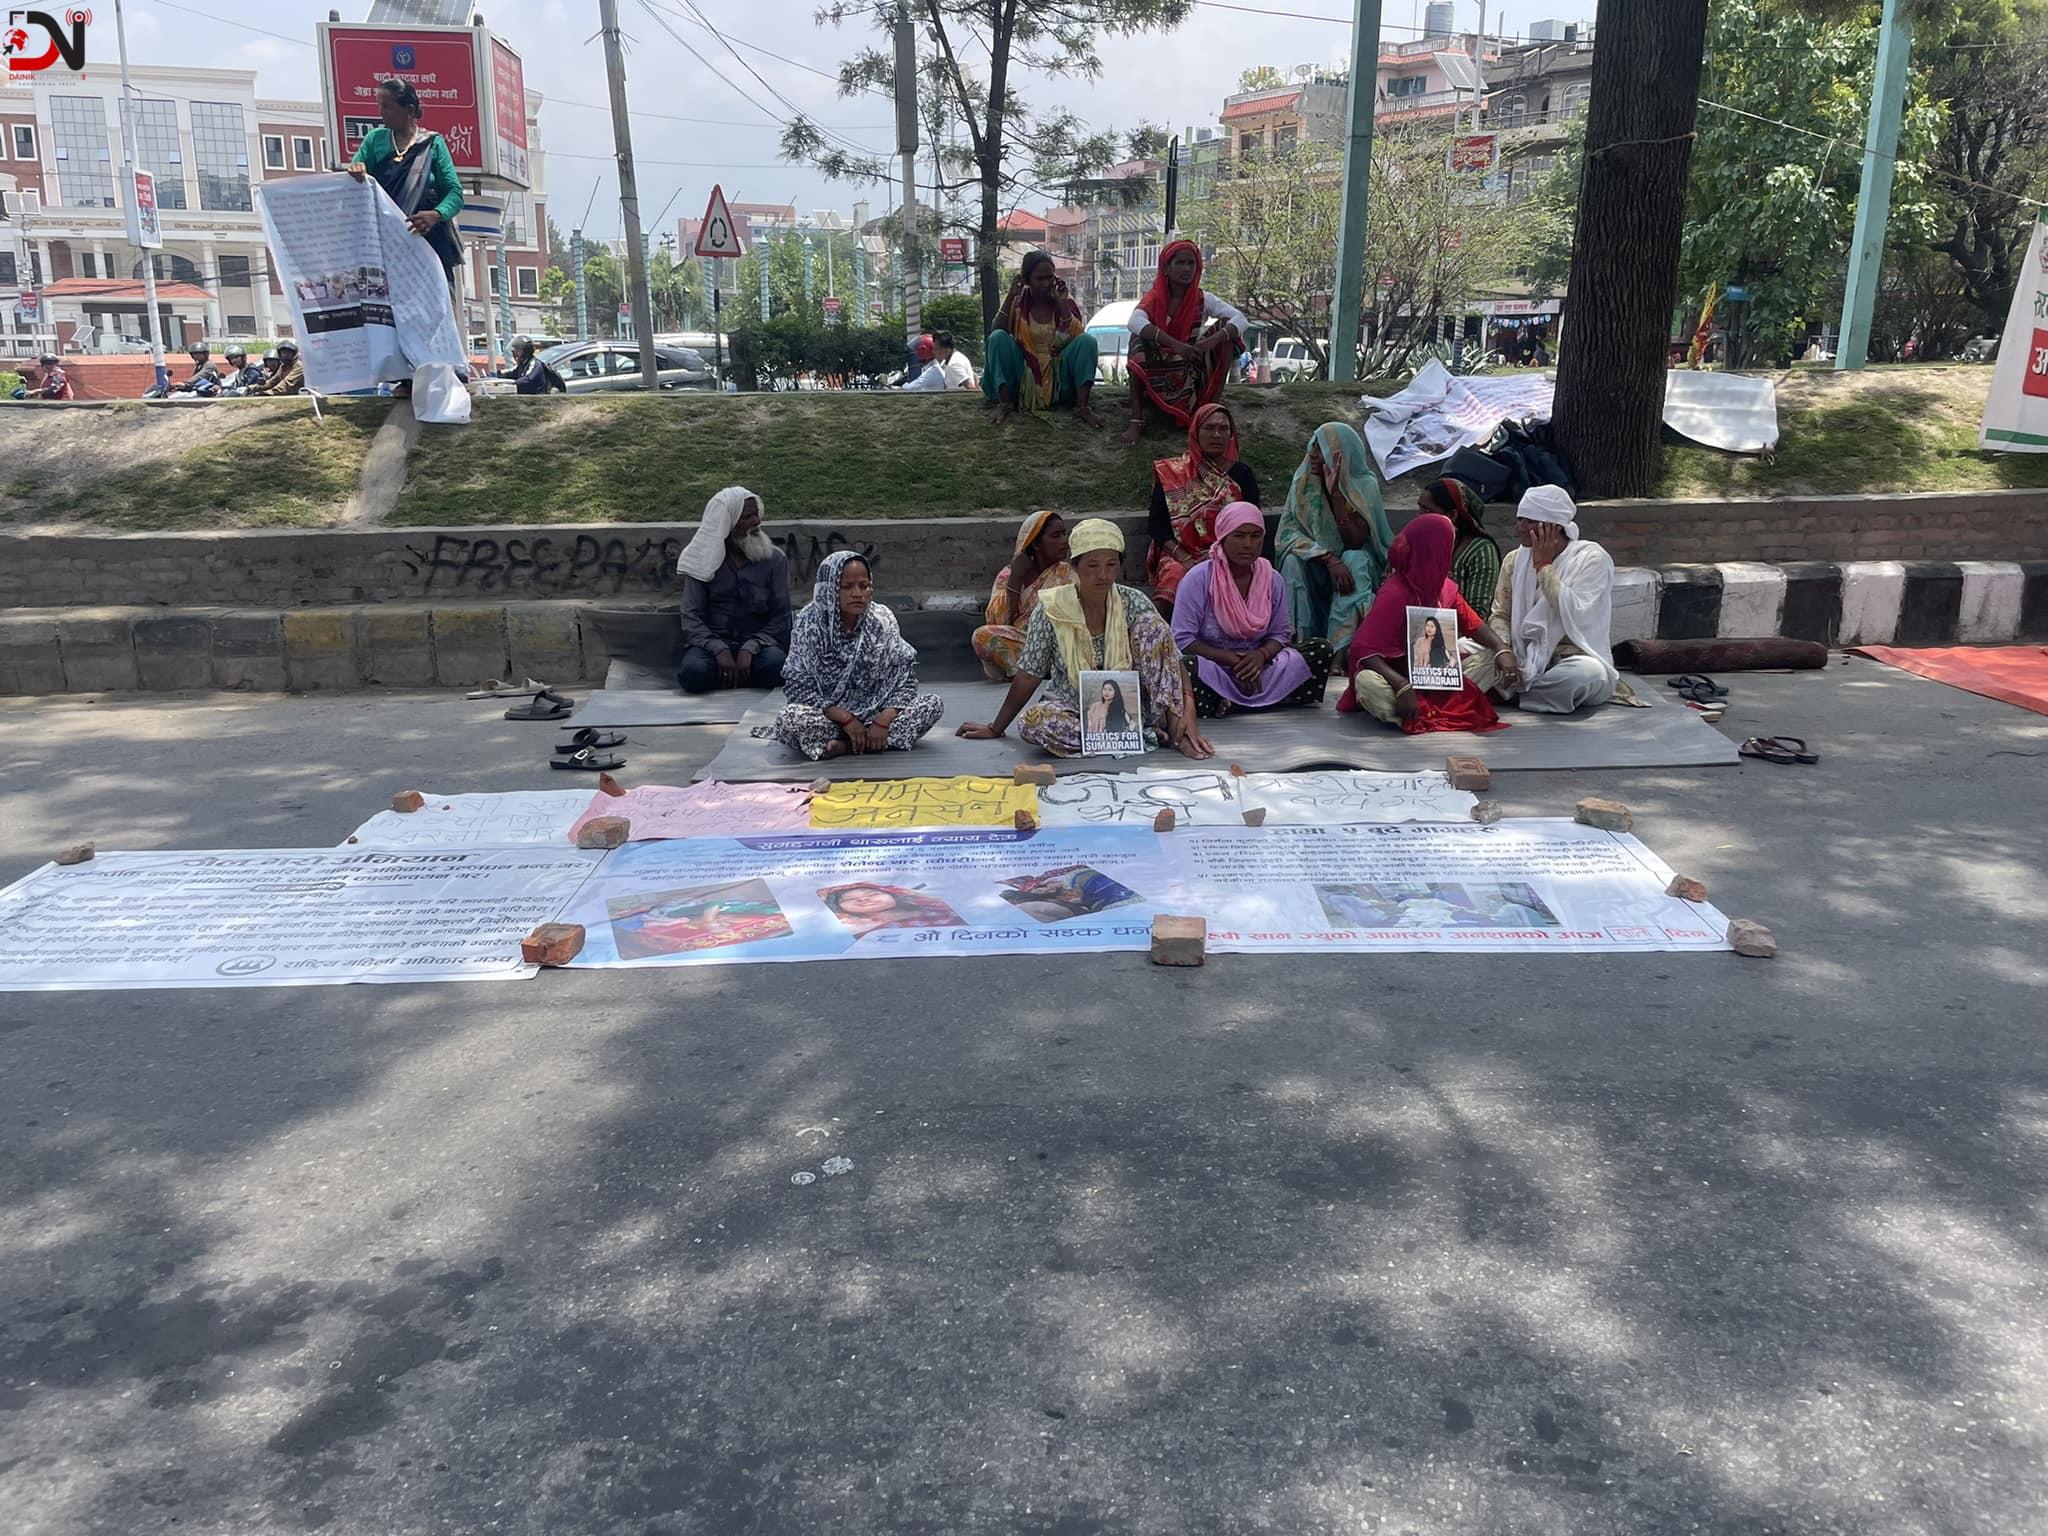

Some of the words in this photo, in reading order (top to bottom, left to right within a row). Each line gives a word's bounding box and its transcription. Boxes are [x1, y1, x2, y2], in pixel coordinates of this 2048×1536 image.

[1444, 668, 1458, 676] FOR
[1413, 676, 1459, 686] SUMADRANI
[1121, 732, 1138, 740] FOR
[1085, 741, 1139, 750] SUMADRANI
[951, 927, 1027, 941] दिनको
